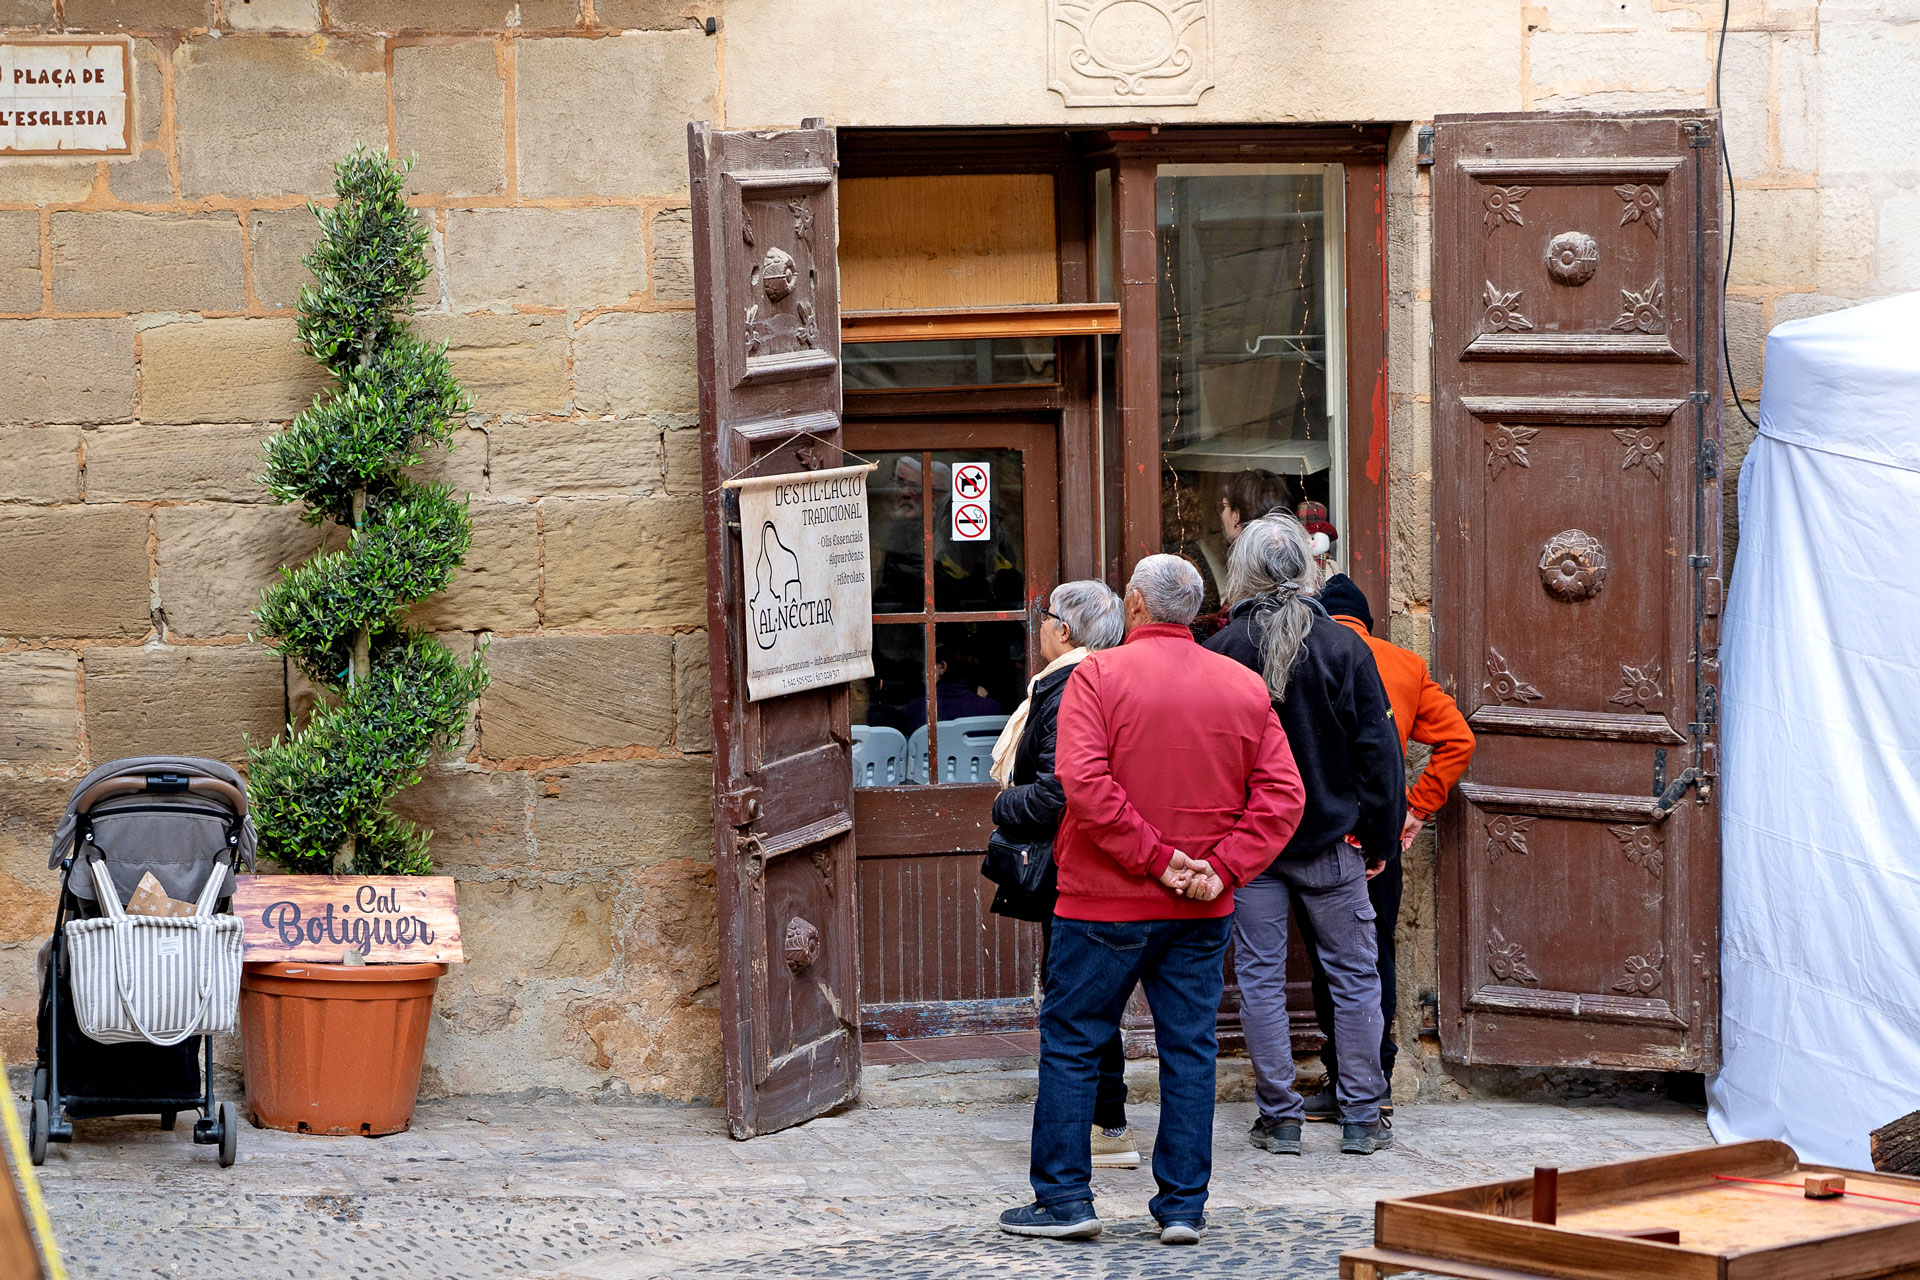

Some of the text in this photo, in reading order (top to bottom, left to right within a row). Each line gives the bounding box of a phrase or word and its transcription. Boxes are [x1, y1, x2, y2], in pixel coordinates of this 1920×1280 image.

[13, 68, 105, 88] PLAÇA DE
[0, 110, 107, 126] L'ESGLESIA
[802, 502, 862, 527] TRADICIONAL
[820, 530, 864, 548] Olis Essencials
[836, 570, 866, 586] Hidrolats
[355, 885, 401, 914] Cal
[261, 901, 435, 956] Botiguer
